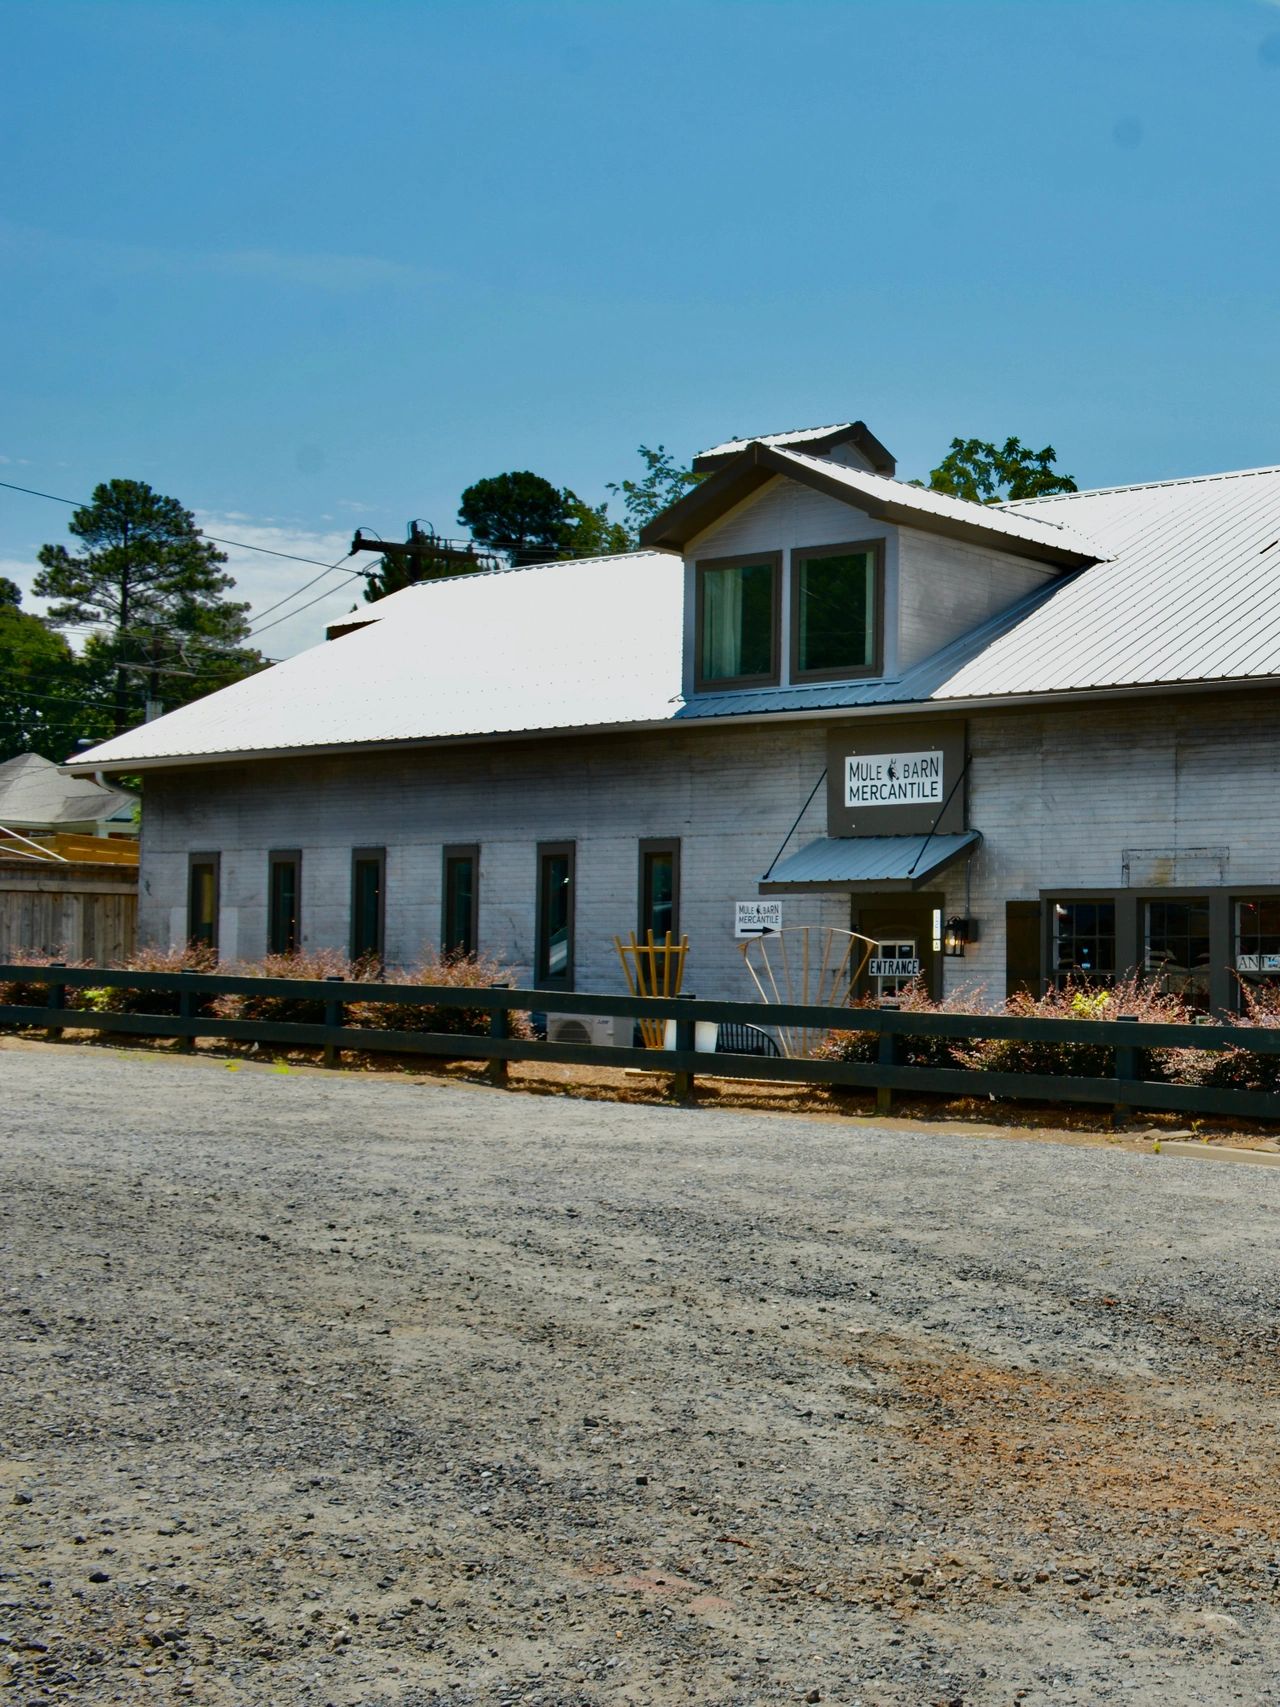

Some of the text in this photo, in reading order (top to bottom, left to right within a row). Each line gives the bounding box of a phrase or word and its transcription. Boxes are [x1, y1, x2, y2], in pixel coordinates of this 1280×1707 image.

[849, 756, 940, 782] MULE BARN
[849, 780, 939, 802] MERCANTILE
[738, 903, 779, 915] MULE BARN
[738, 915, 780, 924] MERCANTILE
[870, 960, 918, 975] ENTRANCE
